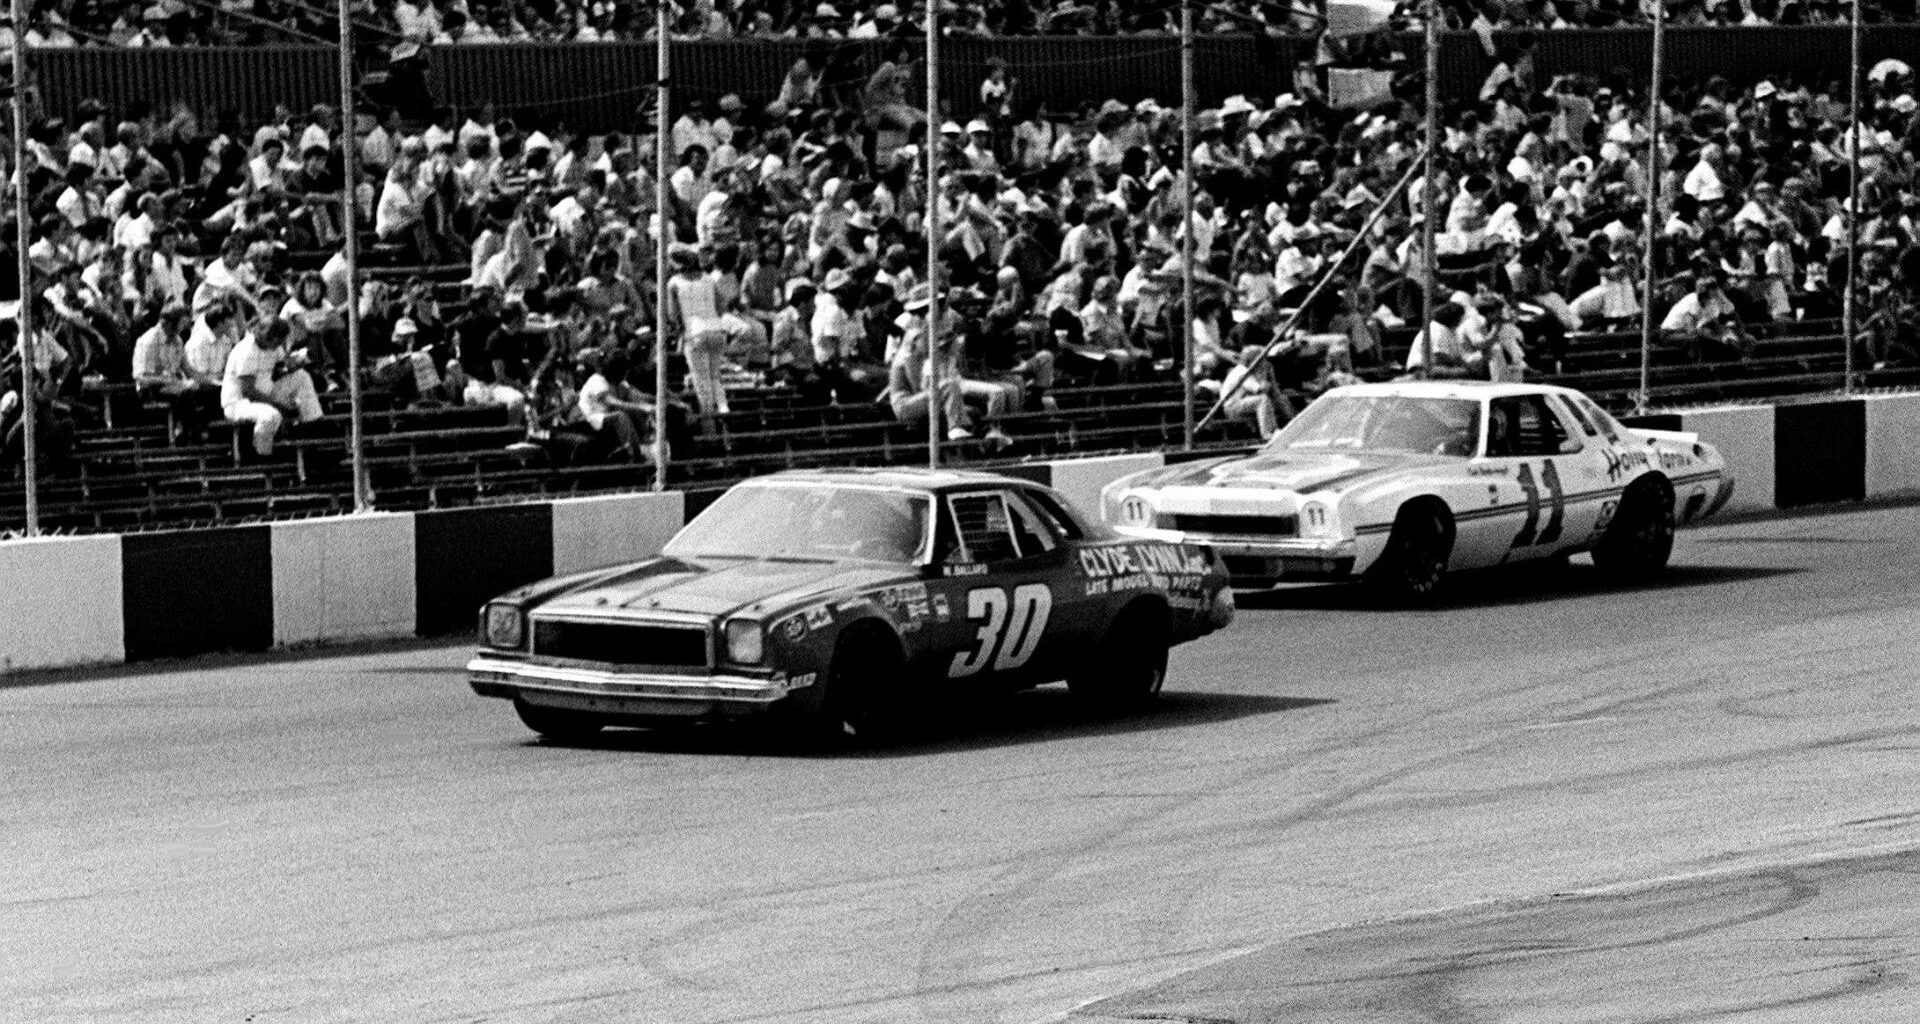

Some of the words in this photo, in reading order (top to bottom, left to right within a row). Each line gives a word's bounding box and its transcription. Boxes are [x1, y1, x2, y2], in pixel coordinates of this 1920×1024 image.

[1127, 502, 1143, 520] 11
[1307, 506, 1326, 526] 11
[1510, 459, 1564, 548] 11
[1079, 546, 1141, 577] CLYDE
[948, 582, 1054, 679] 30
